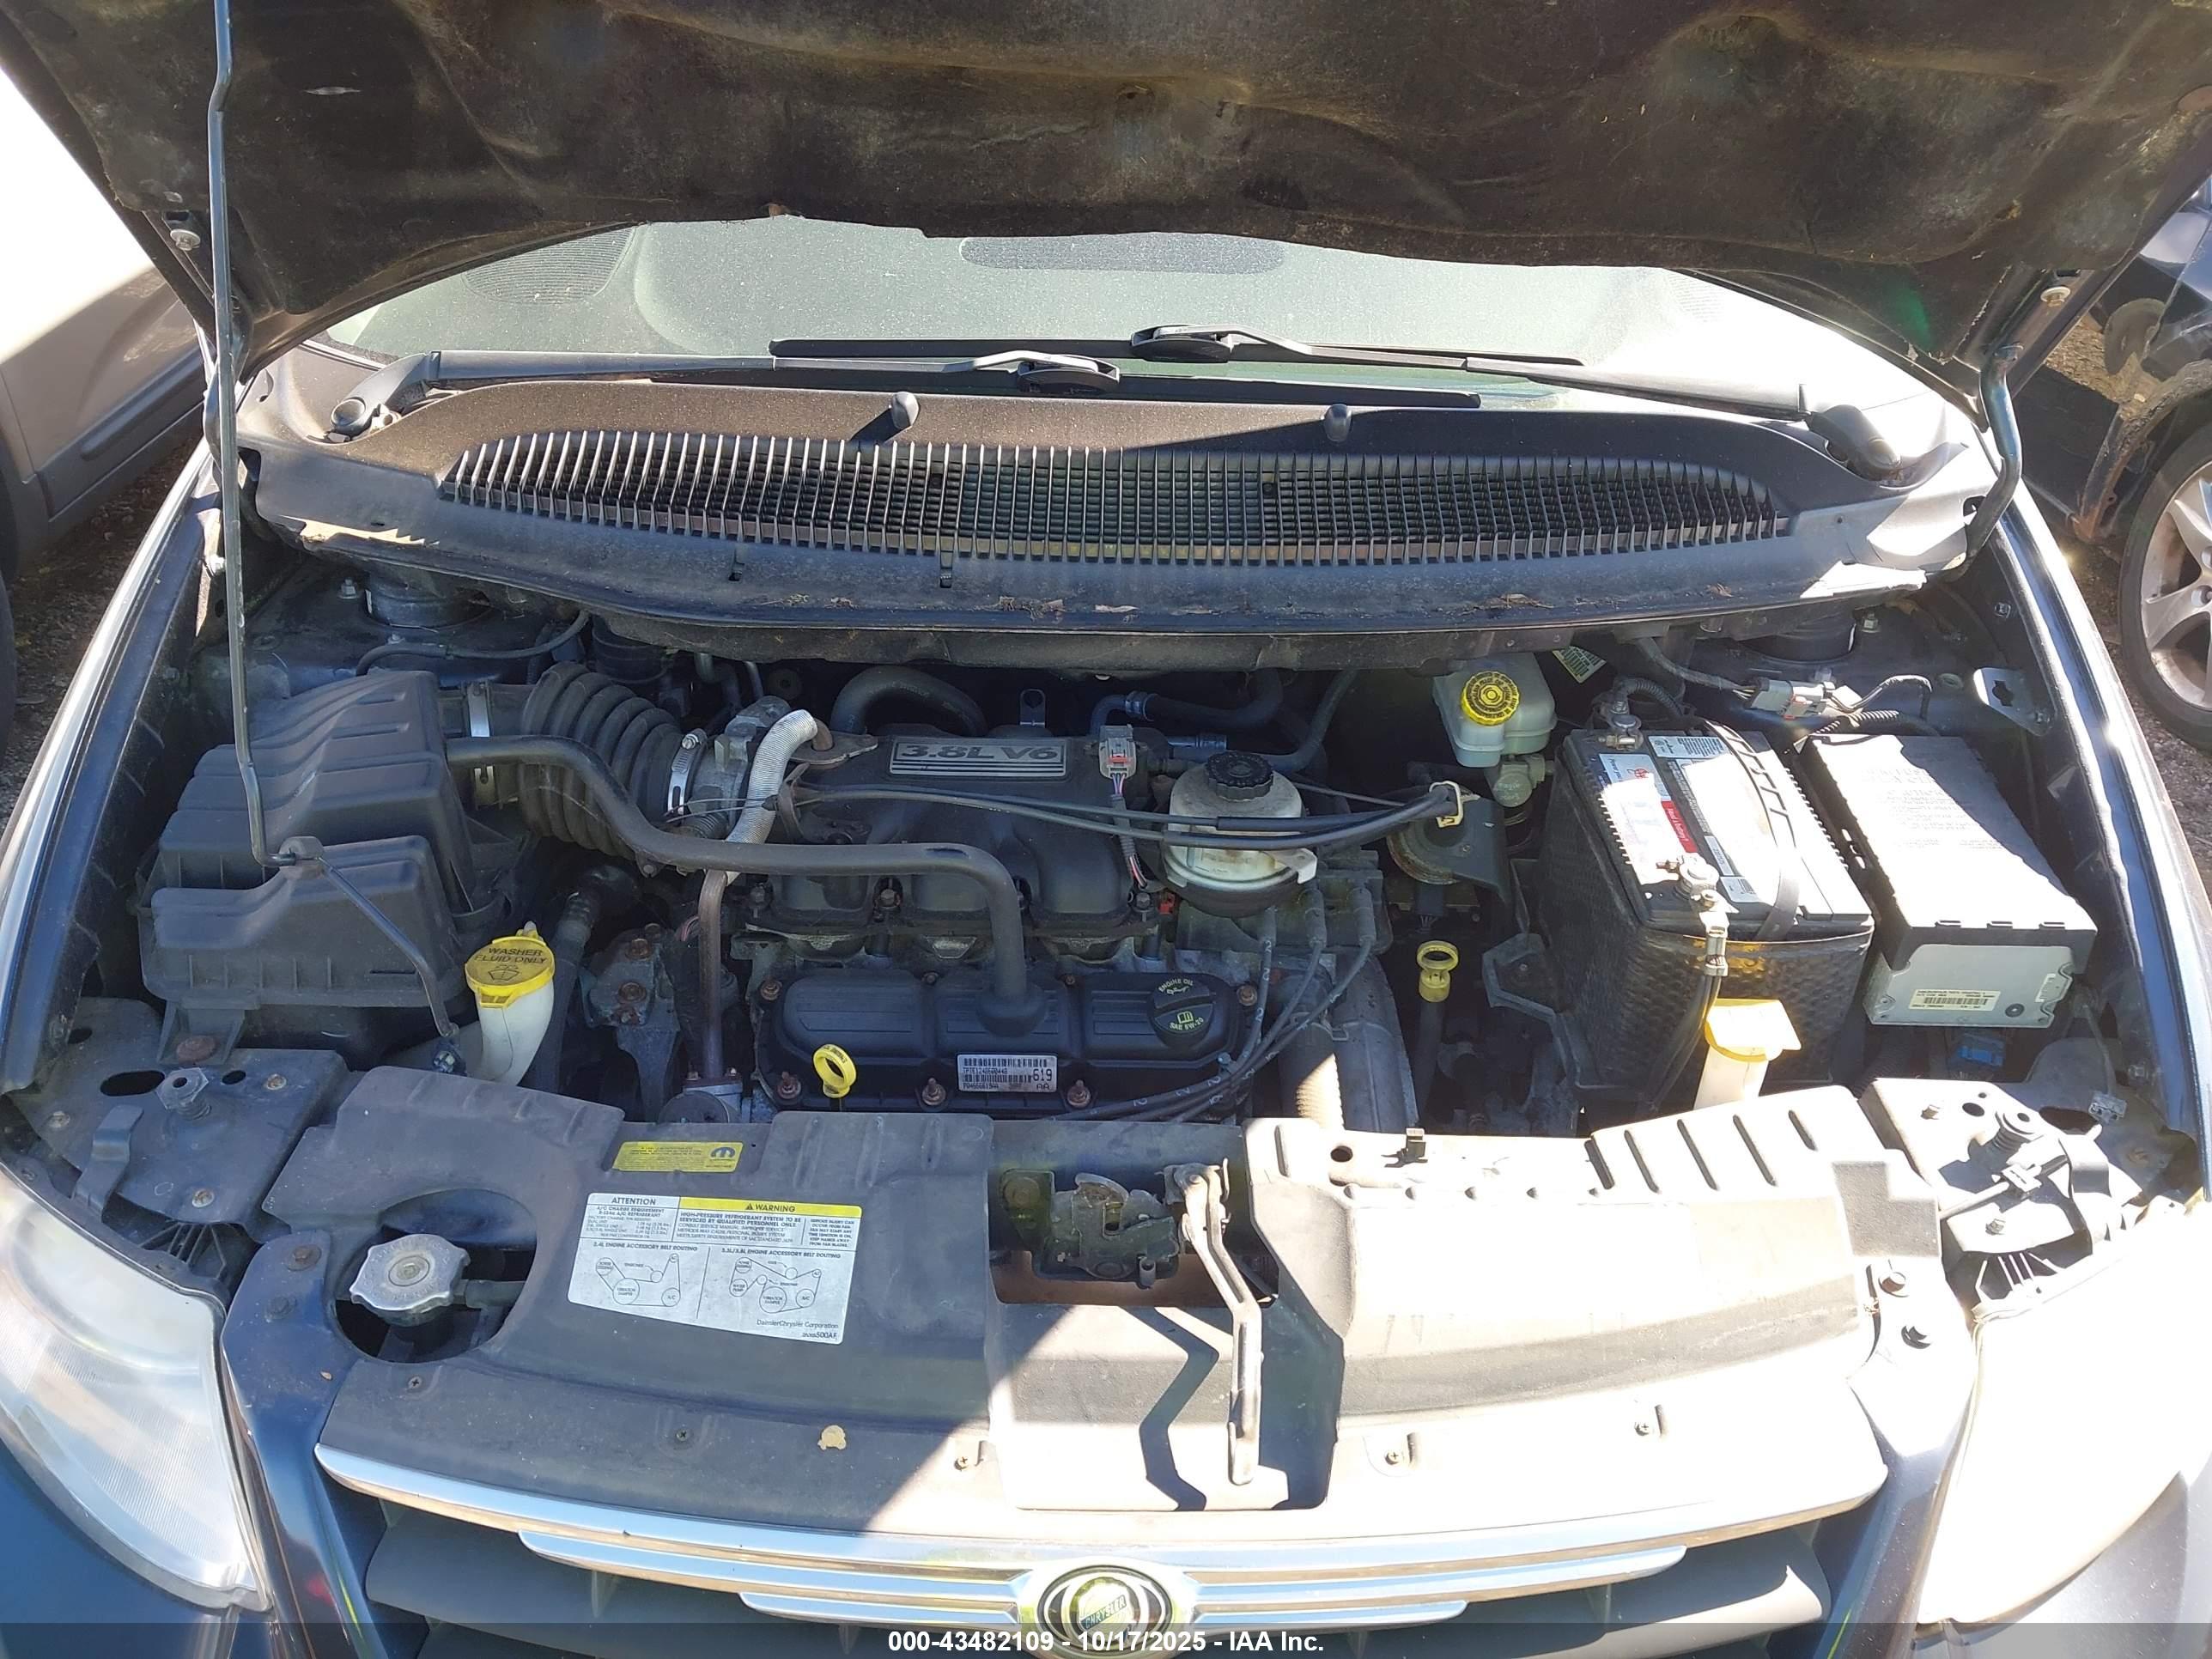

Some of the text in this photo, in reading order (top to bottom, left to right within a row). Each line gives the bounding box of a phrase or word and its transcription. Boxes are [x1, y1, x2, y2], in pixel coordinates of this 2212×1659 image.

[902, 744, 1059, 760] 3.8L V6
[489, 947, 544, 956] WASHER
[474, 954, 547, 963] FLUID ONLY
[1158, 978, 1182, 993] ENGINE
[1170, 1022, 1182, 1030] SAE
[1032, 1068, 1053, 1082] 619
[611, 1197, 656, 1206] ATTENTION
[755, 1204, 796, 1212] WARNING
[757, 1319, 839, 1330] DaimlerChrysler Corporation
[1084, 1594, 1127, 1632] CHRYSLER
